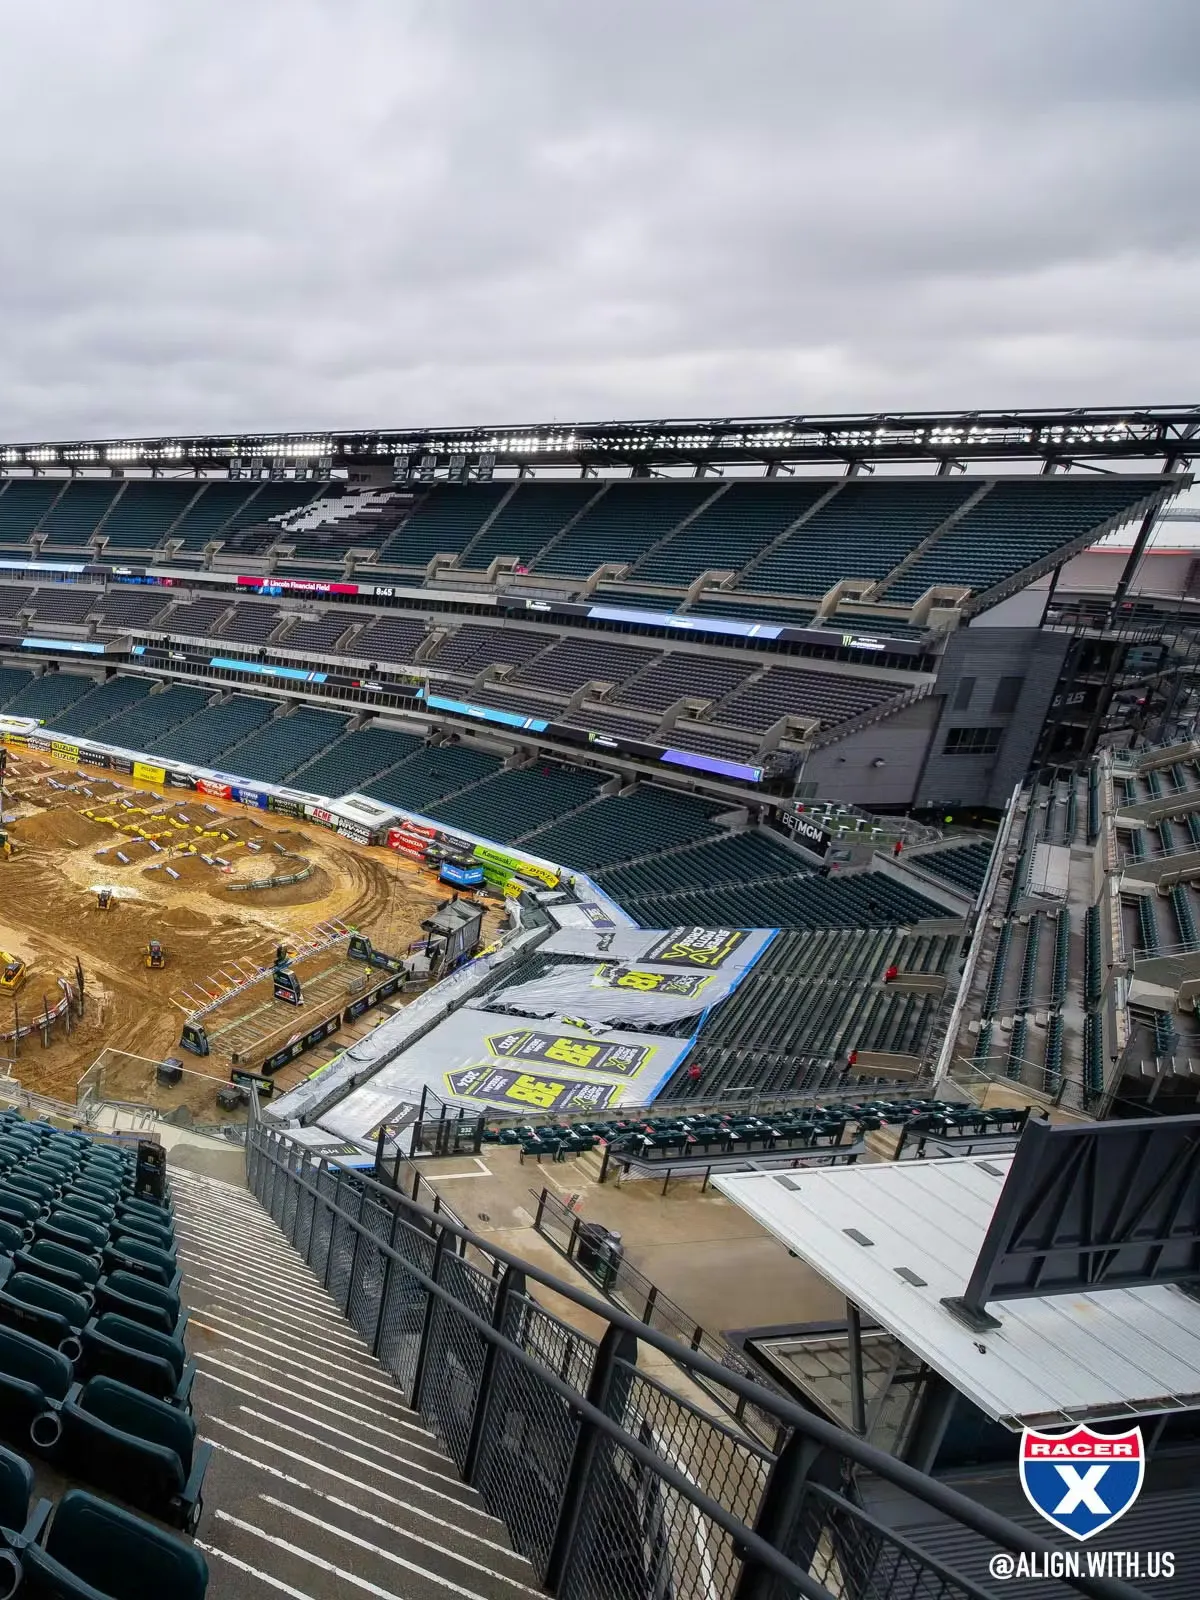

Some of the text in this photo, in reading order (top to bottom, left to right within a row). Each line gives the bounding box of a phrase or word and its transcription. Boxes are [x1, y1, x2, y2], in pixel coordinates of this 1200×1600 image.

[291, 582, 315, 590] Financial
[376, 588, 393, 596] 8:45
[53, 742, 79, 754] SUZUKI
[53, 751, 79, 763] SUZUKI
[313, 807, 332, 821] ACME
[782, 812, 823, 843] BETMGM
[400, 835, 424, 849] HONDA
[482, 849, 512, 865] Kawasaki
[498, 1035, 519, 1049] 2023
[544, 1037, 601, 1068] 38
[456, 1070, 480, 1087] 2024
[505, 1074, 566, 1108] 38
